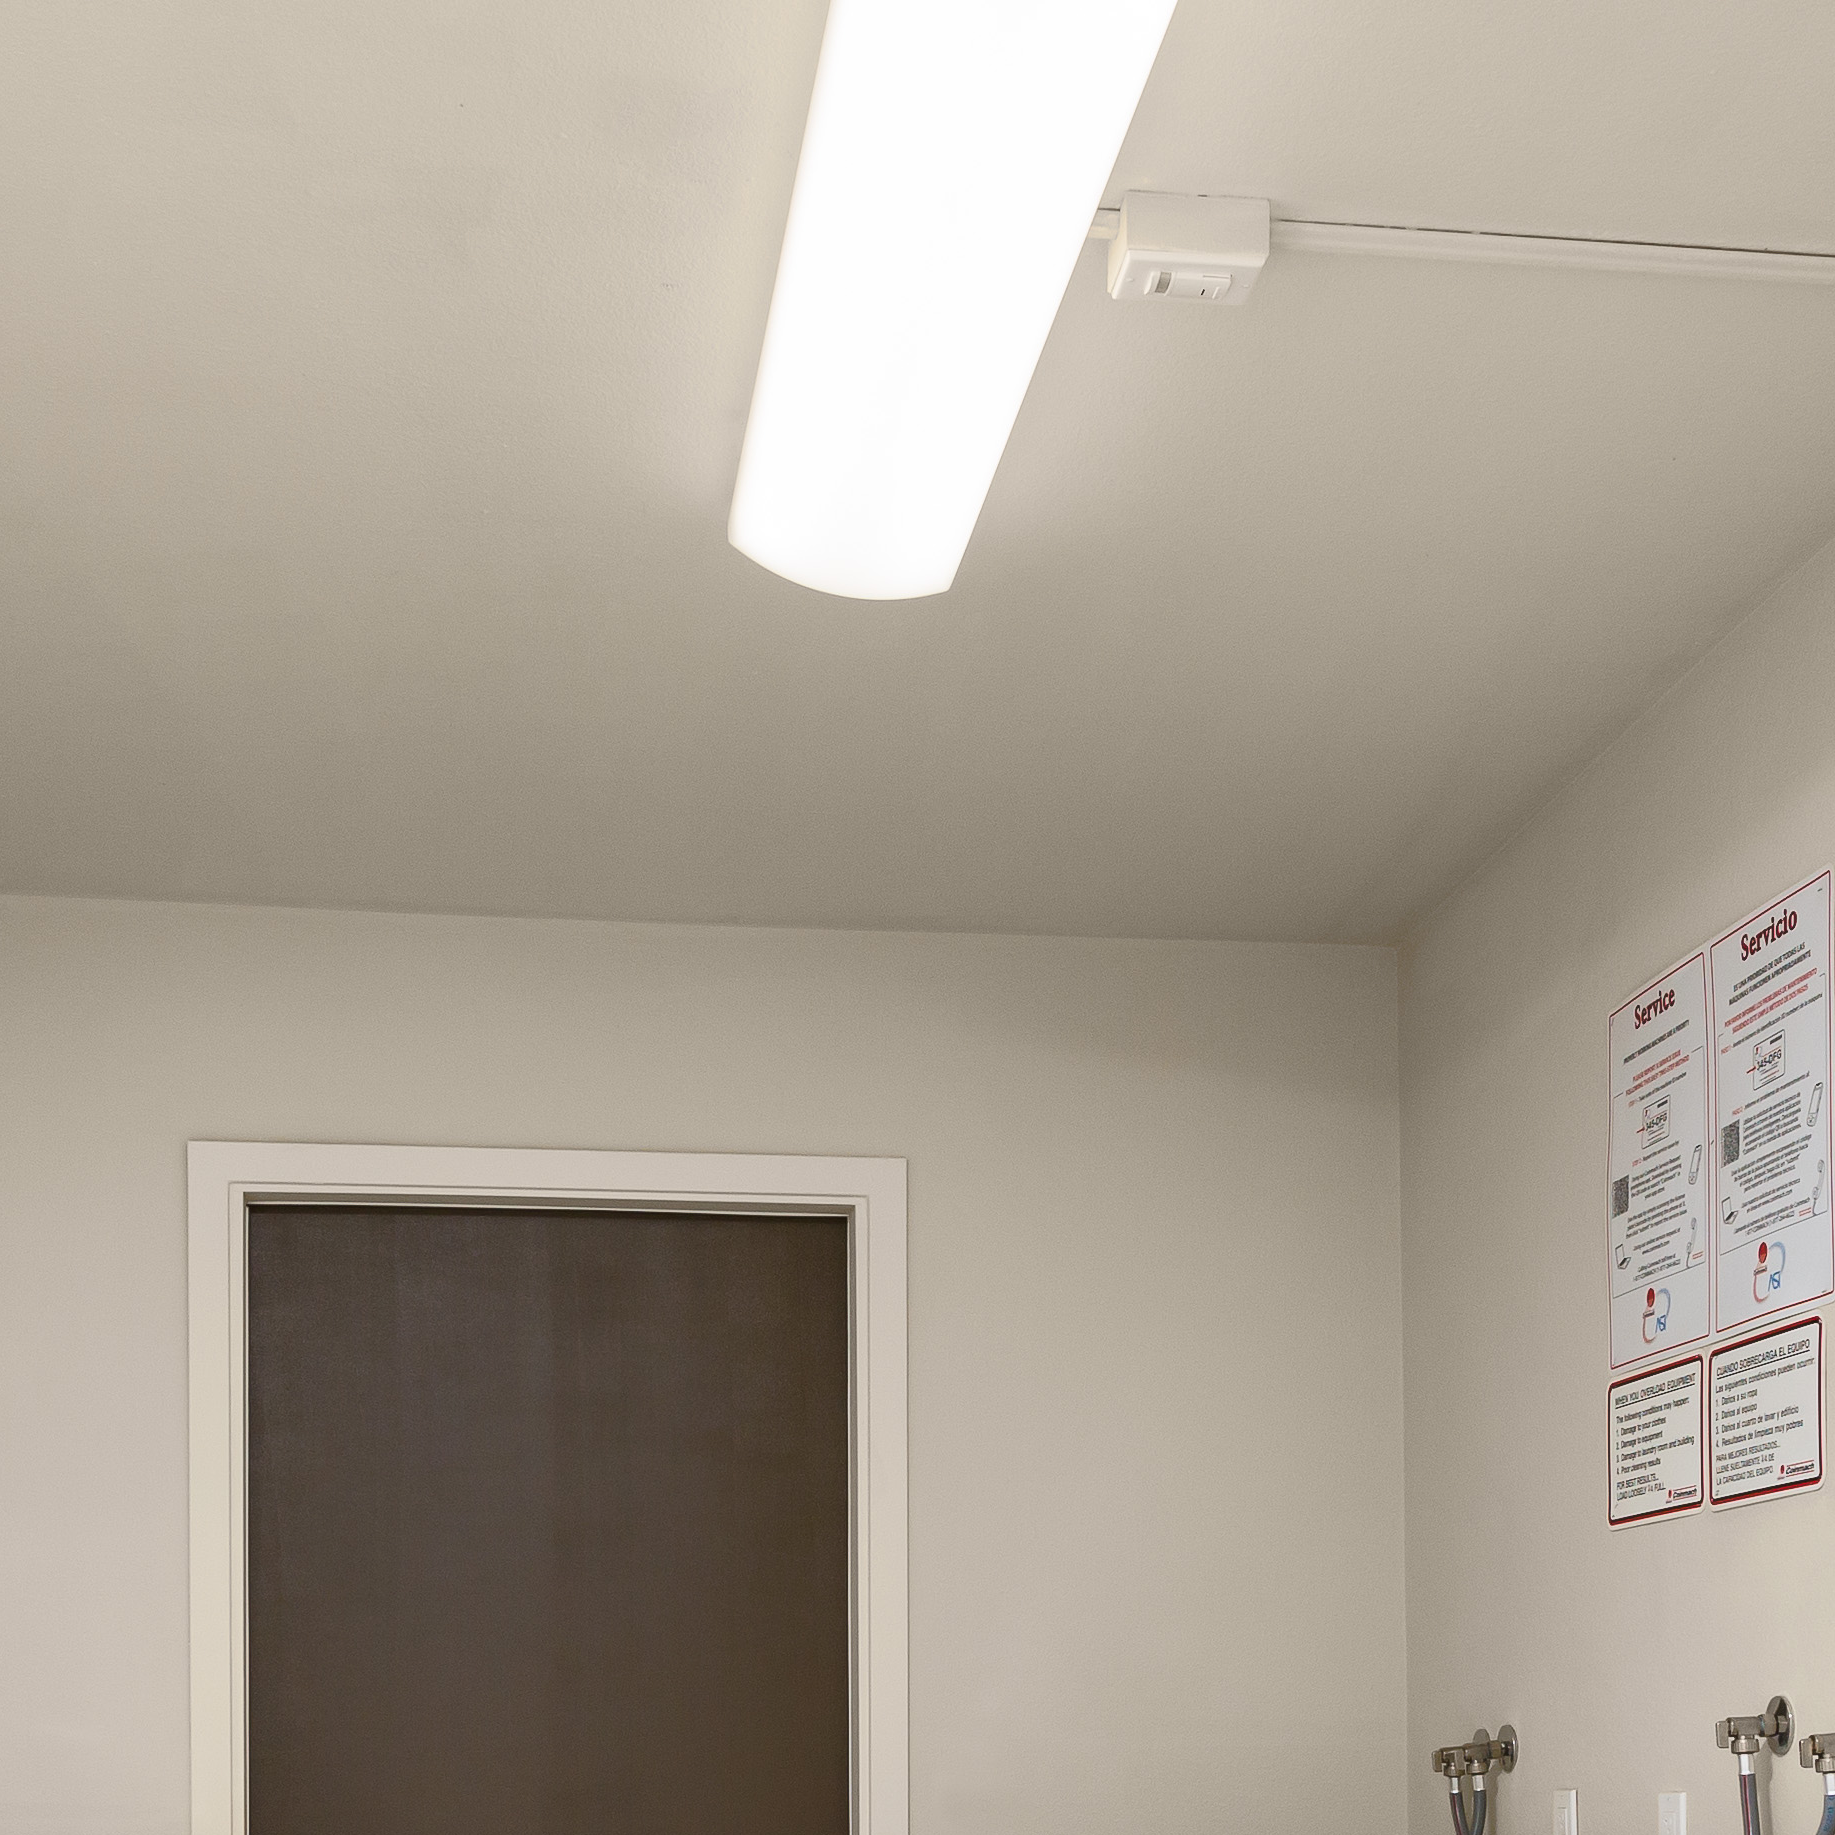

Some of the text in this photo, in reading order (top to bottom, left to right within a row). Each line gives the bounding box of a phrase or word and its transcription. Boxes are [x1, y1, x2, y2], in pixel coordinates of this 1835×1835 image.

[1740, 908, 1797, 961] Servicio
[1634, 988, 1675, 1029] Service
[1716, 1338, 1810, 1376] CUANDO SOBRECARGA EL EQUIPO
[1614, 1372, 1696, 1405] WHEN YOU OVERLOAD EQUIPMENT
